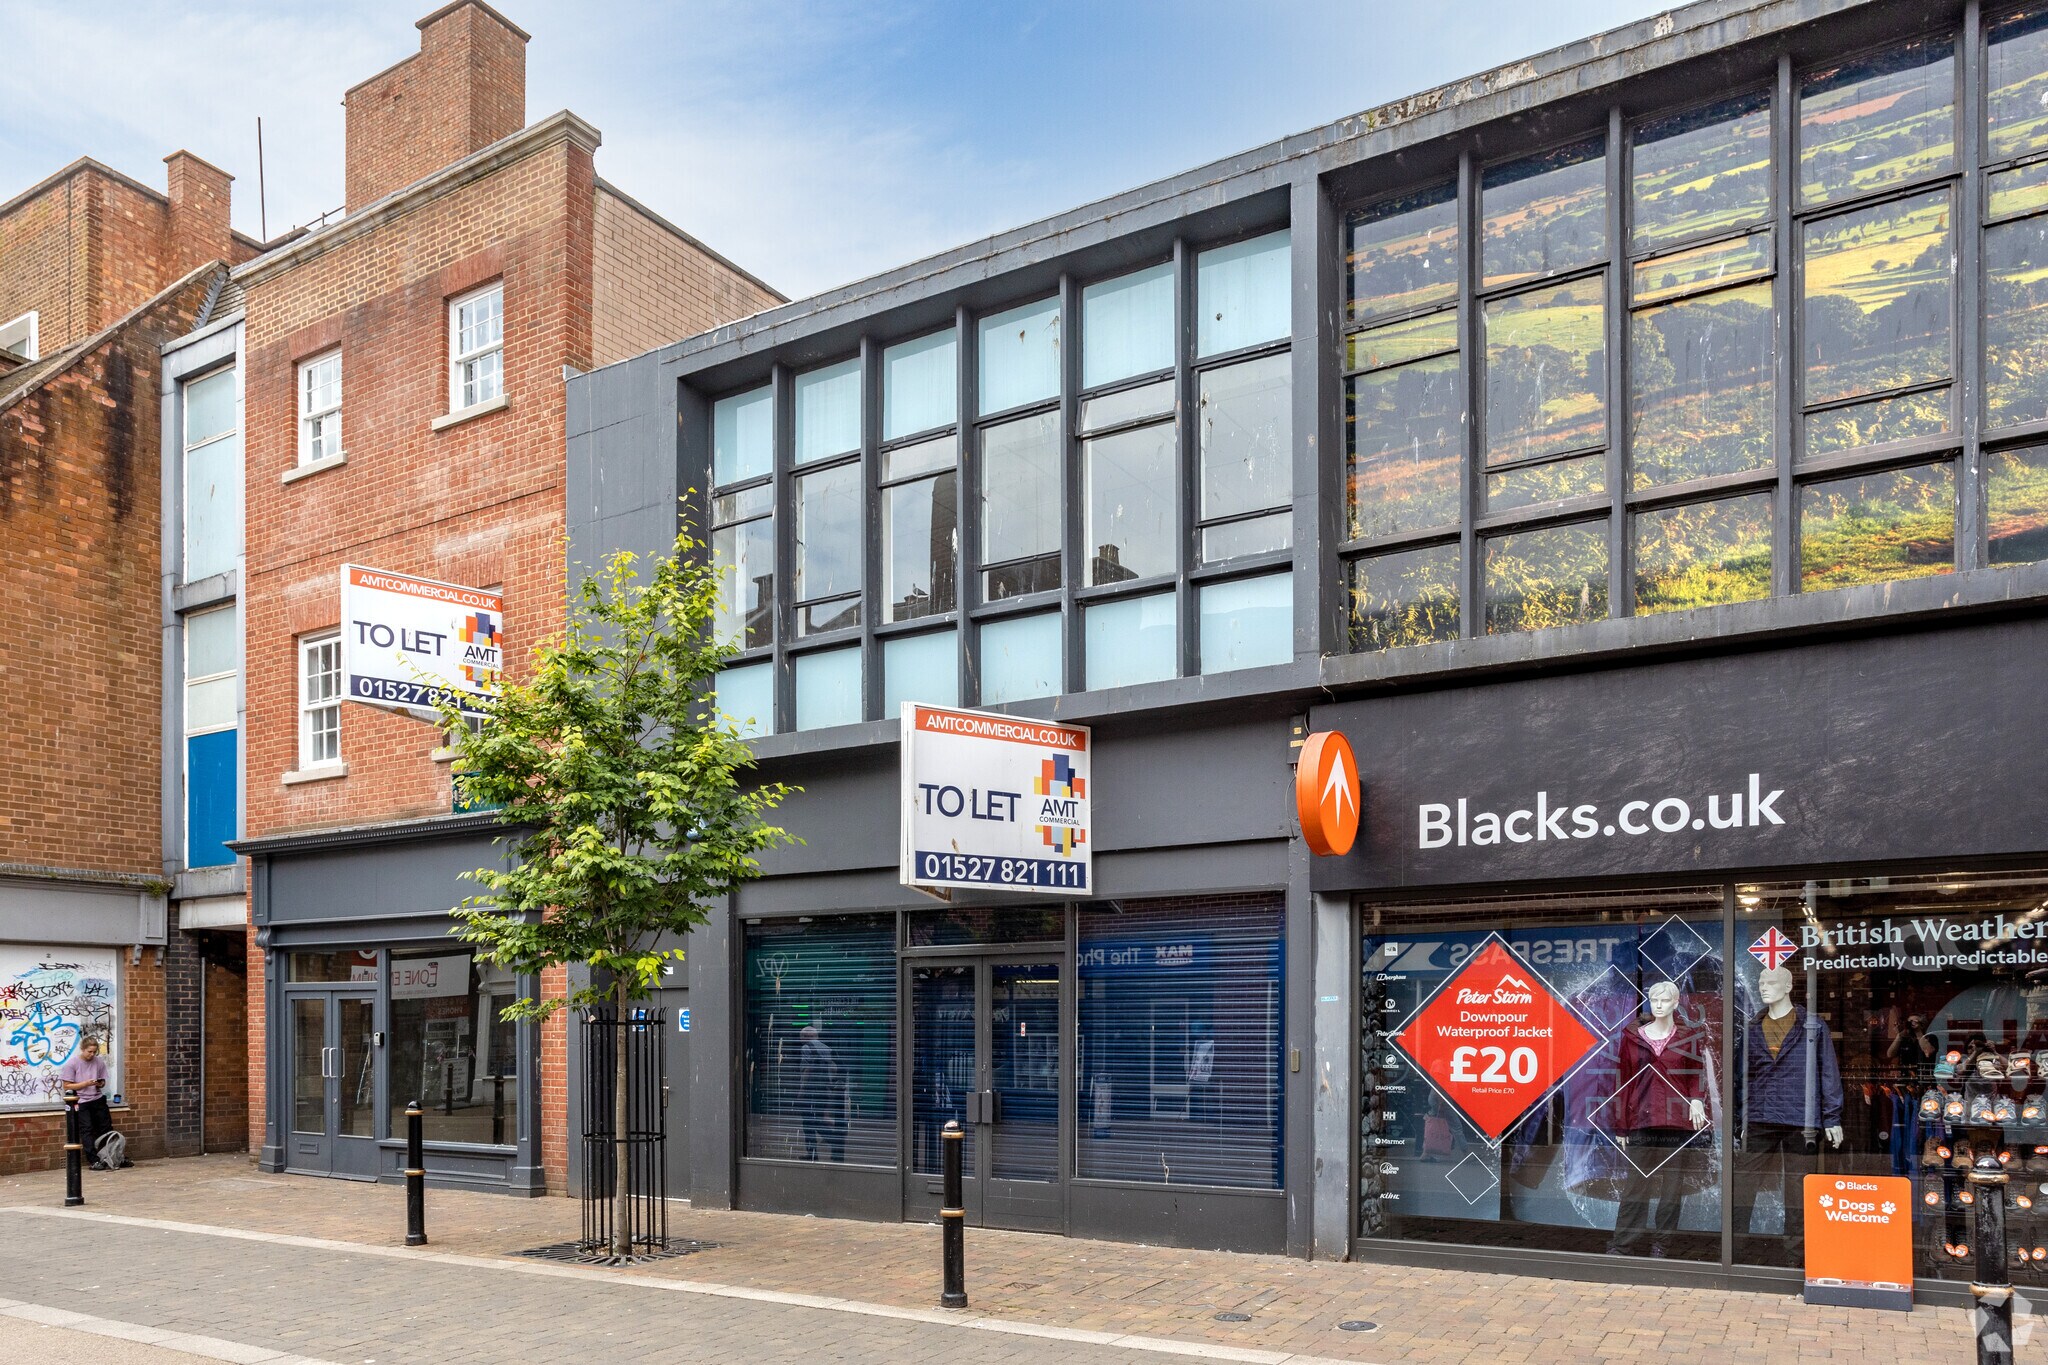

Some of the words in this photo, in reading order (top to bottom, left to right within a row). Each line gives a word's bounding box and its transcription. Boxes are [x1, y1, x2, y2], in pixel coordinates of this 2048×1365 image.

[360, 573, 497, 609] AMTCOMMERCIAL.CO.UK
[353, 620, 395, 648] TO
[401, 628, 447, 656] LET
[462, 657, 500, 670] COMMERCIAL
[465, 645, 497, 663] AMT
[359, 678, 425, 703] 01527
[926, 714, 1077, 747] AMTCOMMERCIAL.CO.UK
[918, 783, 965, 818] TO
[971, 788, 1022, 822] LET
[1040, 798, 1079, 818] AMT
[1419, 773, 1786, 849] Blacks.co.uk
[1039, 816, 1080, 826] COMMERCIAL
[925, 854, 996, 881] 01527
[1000, 859, 1039, 884] 821
[1046, 863, 1079, 886] 111
[1800, 918, 1904, 948] British
[1911, 914, 2048, 942] Weather
[1803, 953, 1907, 971] Predictably
[1912, 949, 2048, 968] unpredictable
[1456, 988, 1492, 1005] Peter
[1492, 988, 1532, 1005] Storm
[1460, 1011, 1528, 1025] Downpour
[1436, 1026, 1510, 1039] Waterproof
[1512, 1026, 1553, 1037] Jacket
[1450, 1046, 1539, 1084] £20
[1846, 1182, 1878, 1191] Blacks
[1839, 1199, 1875, 1212] Dogs
[1825, 1210, 1890, 1224] Welcome
